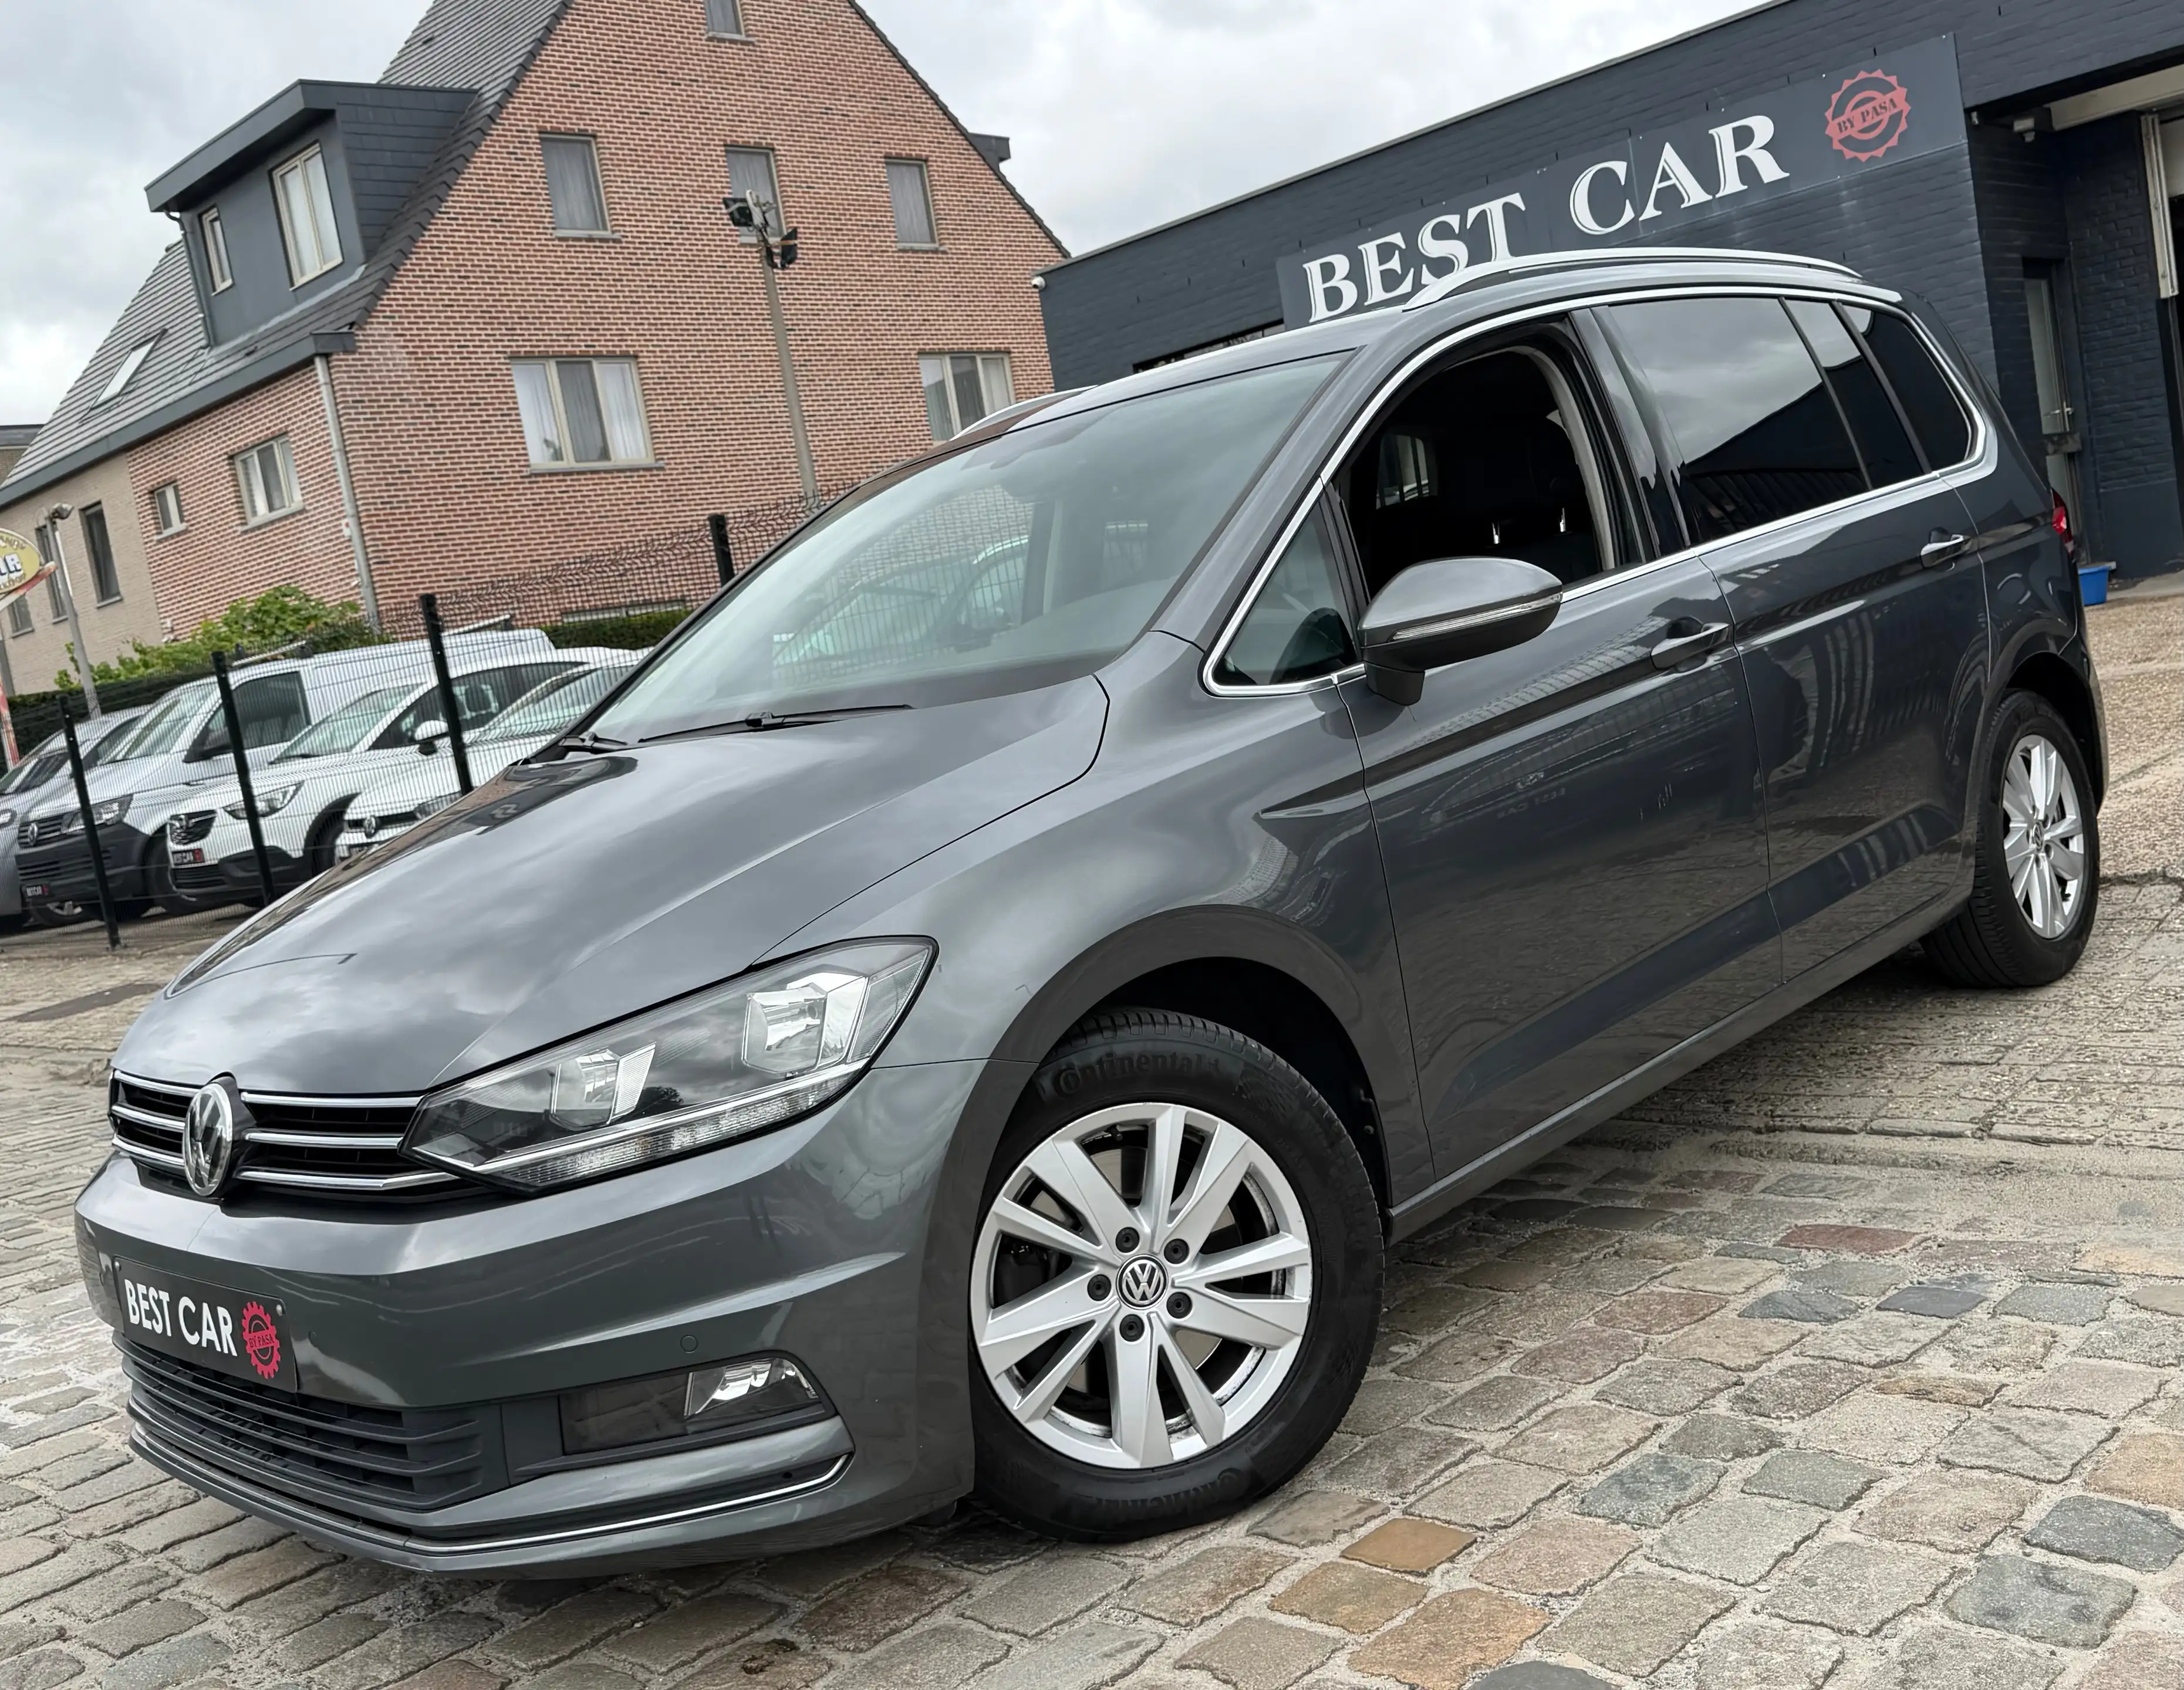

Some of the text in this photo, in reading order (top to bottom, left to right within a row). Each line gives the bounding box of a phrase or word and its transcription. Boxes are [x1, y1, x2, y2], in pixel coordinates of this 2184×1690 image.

[1837, 98, 1898, 133] BY PASA
[1302, 115, 1790, 323] BEST CAR
[124, 1279, 238, 1357] BEST CAR
